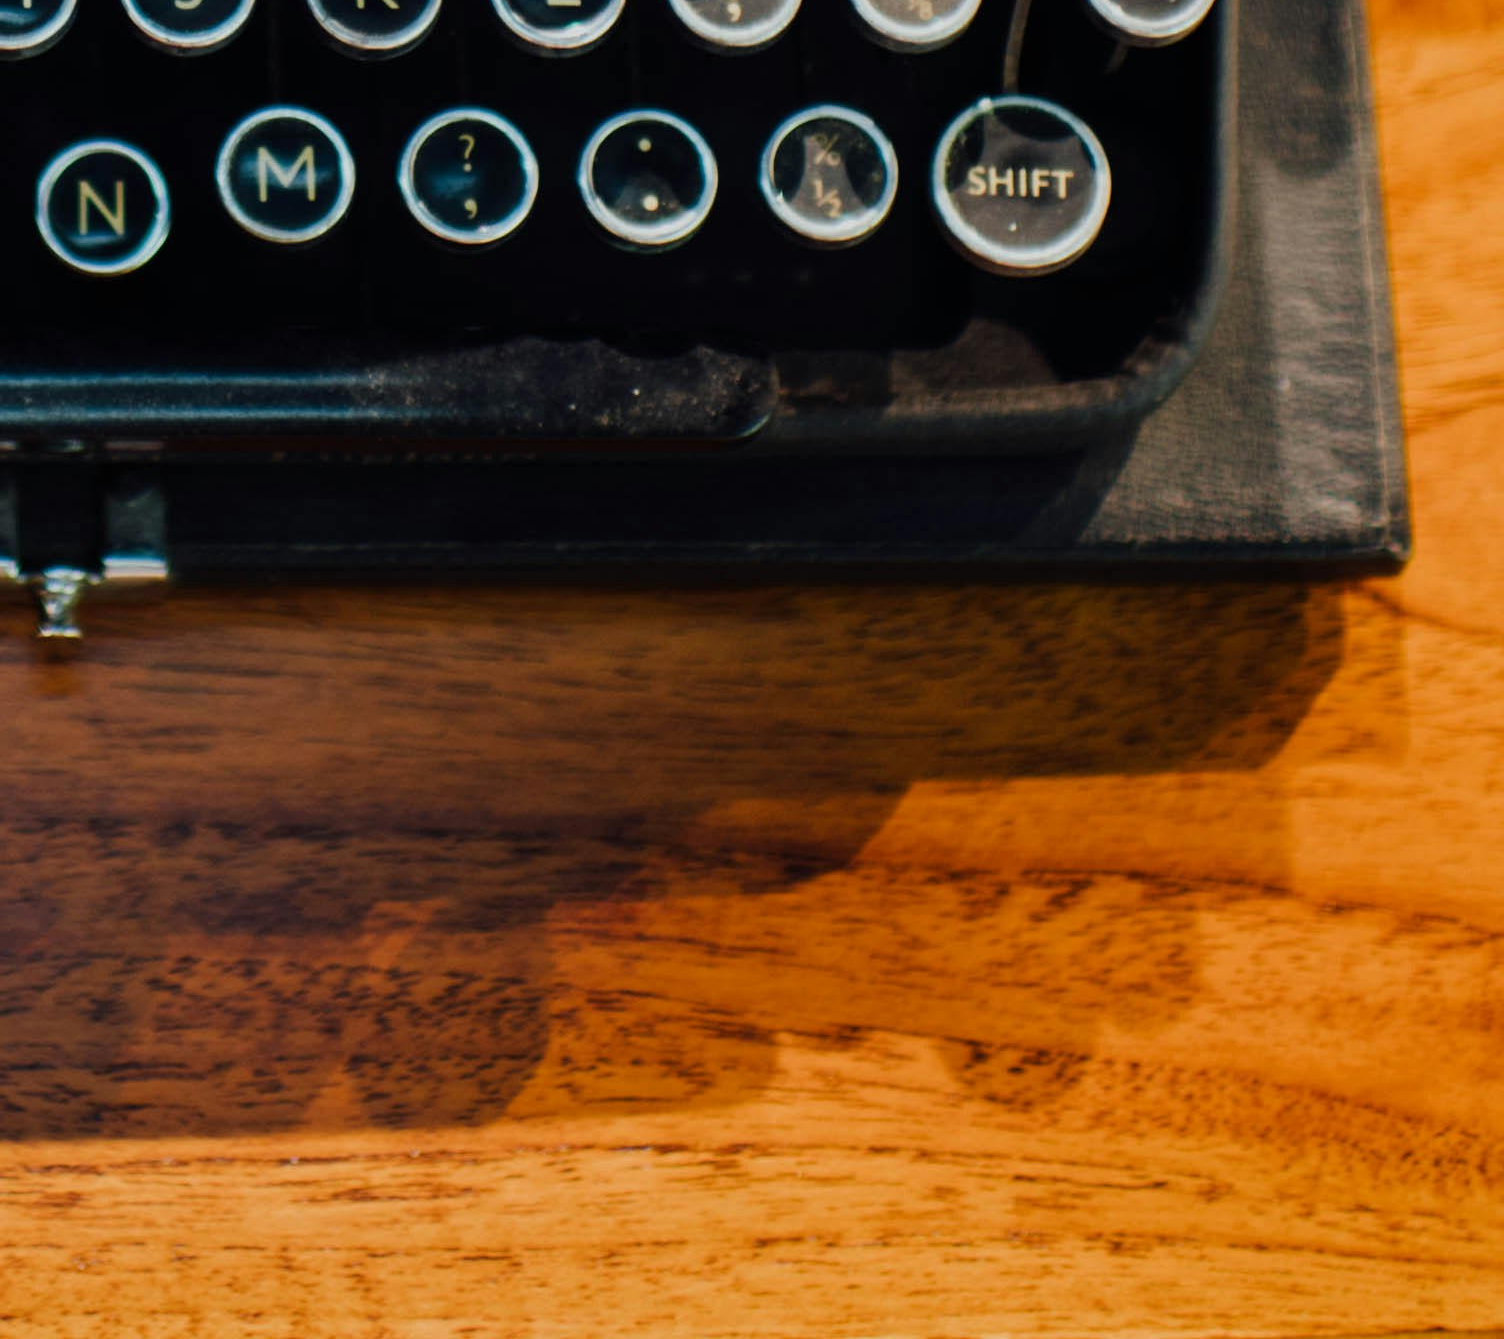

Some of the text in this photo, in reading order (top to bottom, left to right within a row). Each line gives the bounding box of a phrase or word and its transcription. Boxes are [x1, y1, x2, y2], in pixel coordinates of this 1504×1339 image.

[256, 145, 317, 204] M
[966, 166, 1075, 201] SHIFT
[78, 179, 126, 237] N
